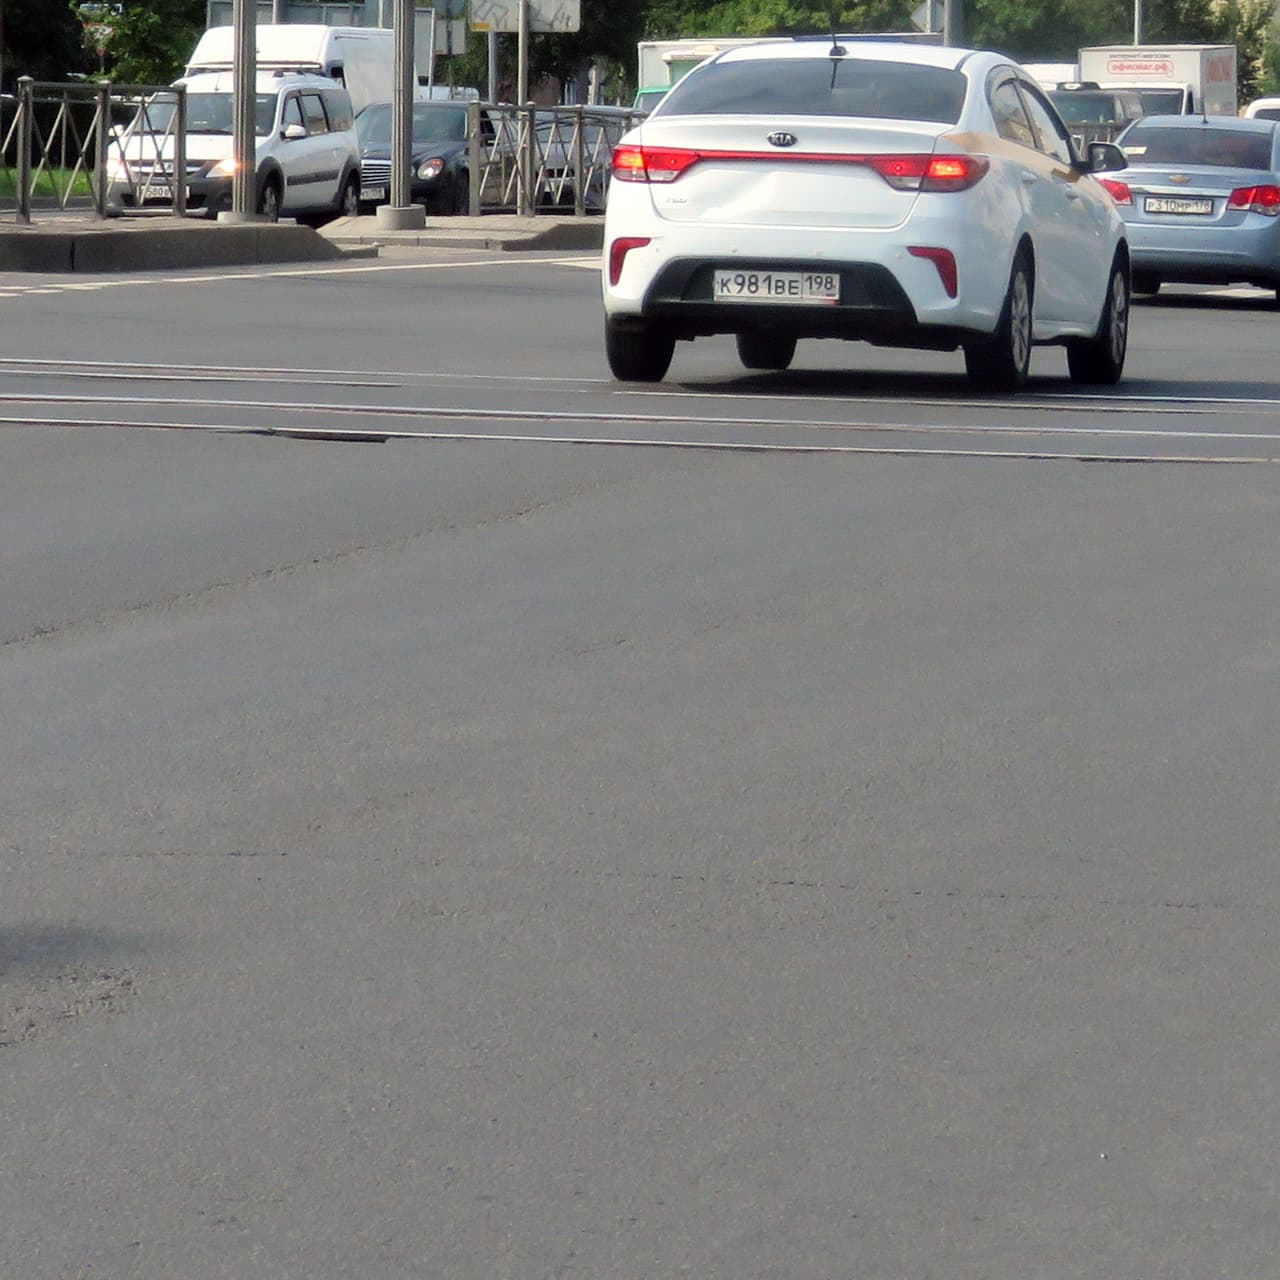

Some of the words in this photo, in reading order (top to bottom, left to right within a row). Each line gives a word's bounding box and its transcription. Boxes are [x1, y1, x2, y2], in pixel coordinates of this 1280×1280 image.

[771, 133, 793, 145] KIA
[719, 273, 800, 296] К981ВЕ
[805, 275, 835, 291] 198
